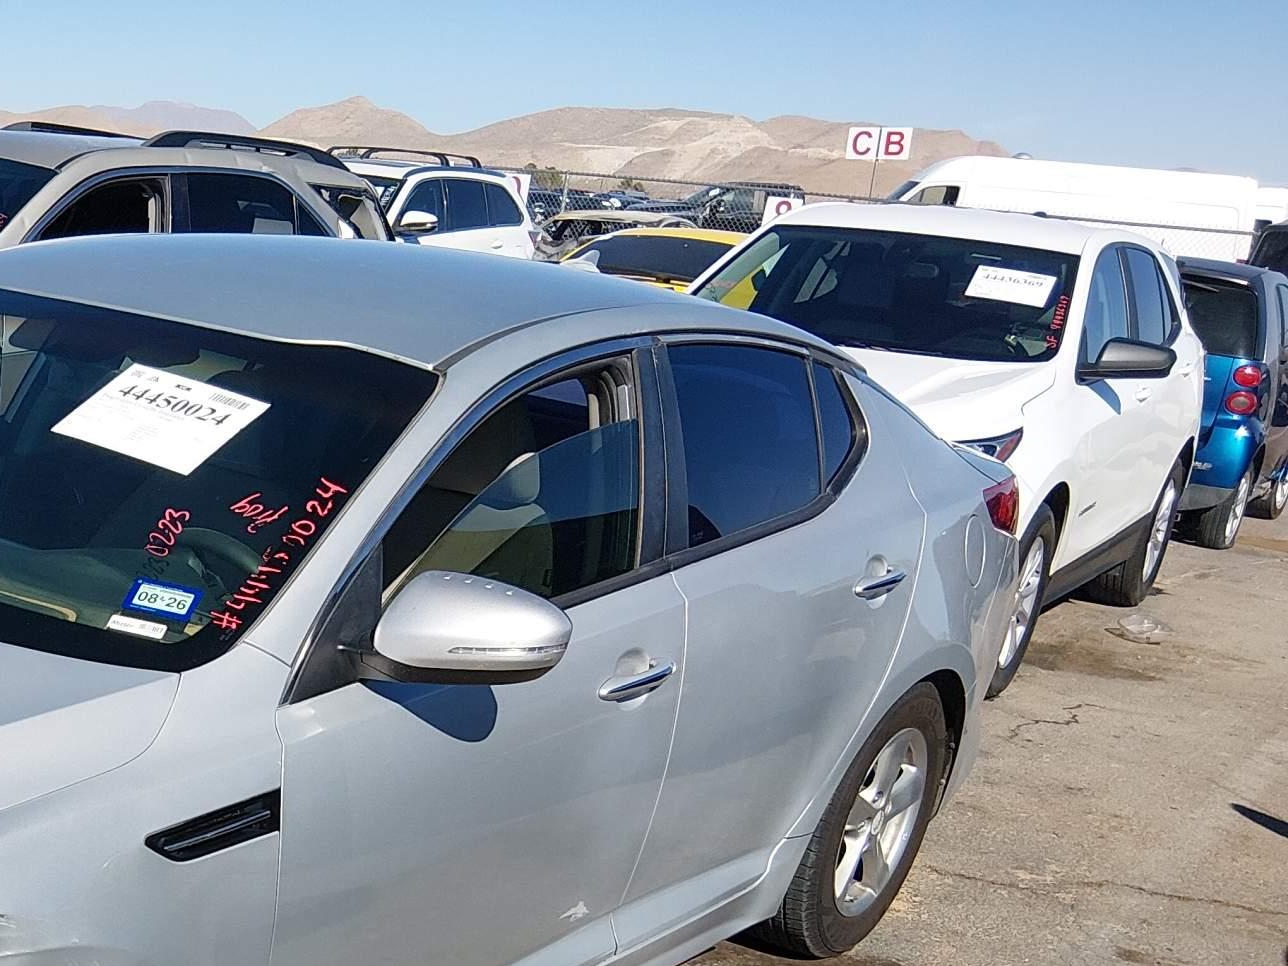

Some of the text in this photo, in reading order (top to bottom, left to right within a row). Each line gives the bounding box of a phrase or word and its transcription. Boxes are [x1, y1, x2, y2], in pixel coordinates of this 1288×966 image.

[852, 130, 905, 156] C B
[119, 384, 232, 426] 44450024
[137, 591, 159, 604] 08
[165, 596, 187, 611] 26
